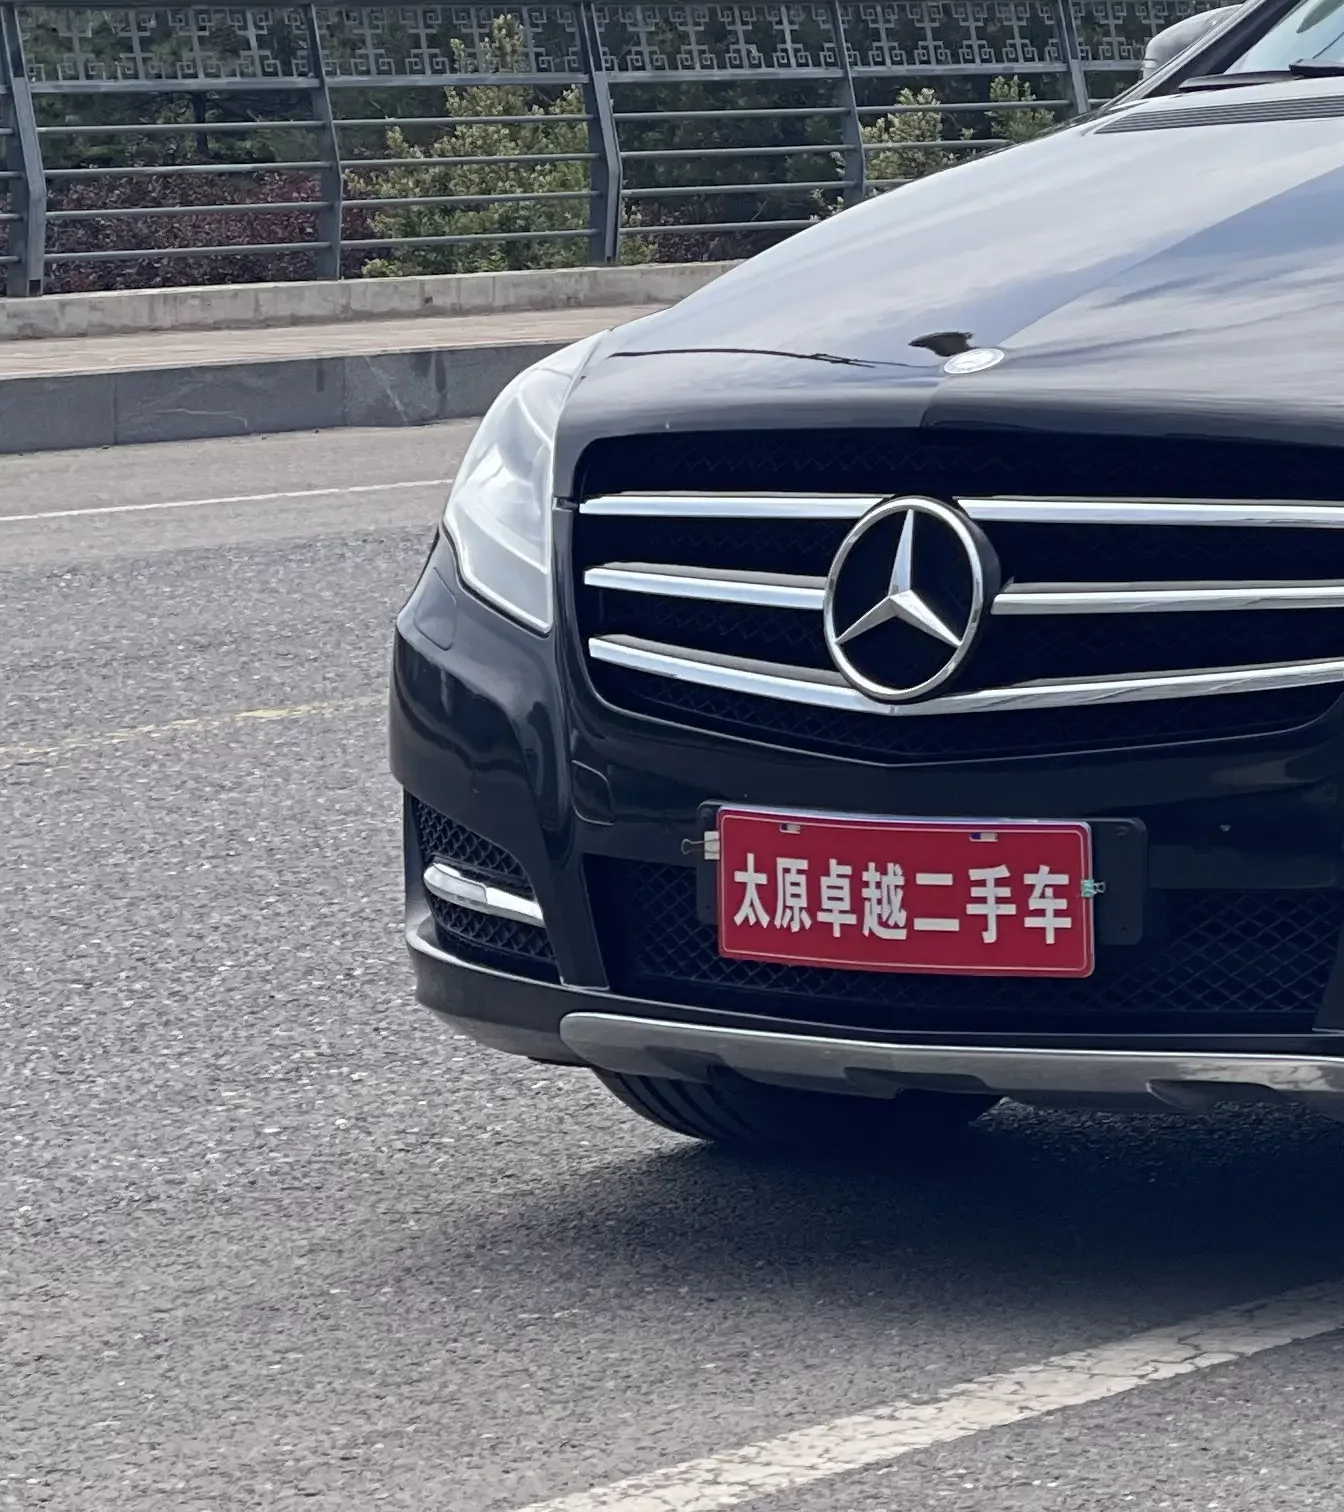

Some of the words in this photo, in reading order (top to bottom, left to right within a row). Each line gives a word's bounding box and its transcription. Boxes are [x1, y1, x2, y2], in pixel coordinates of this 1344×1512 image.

[733, 852, 1073, 945] 太原卓越二手车
